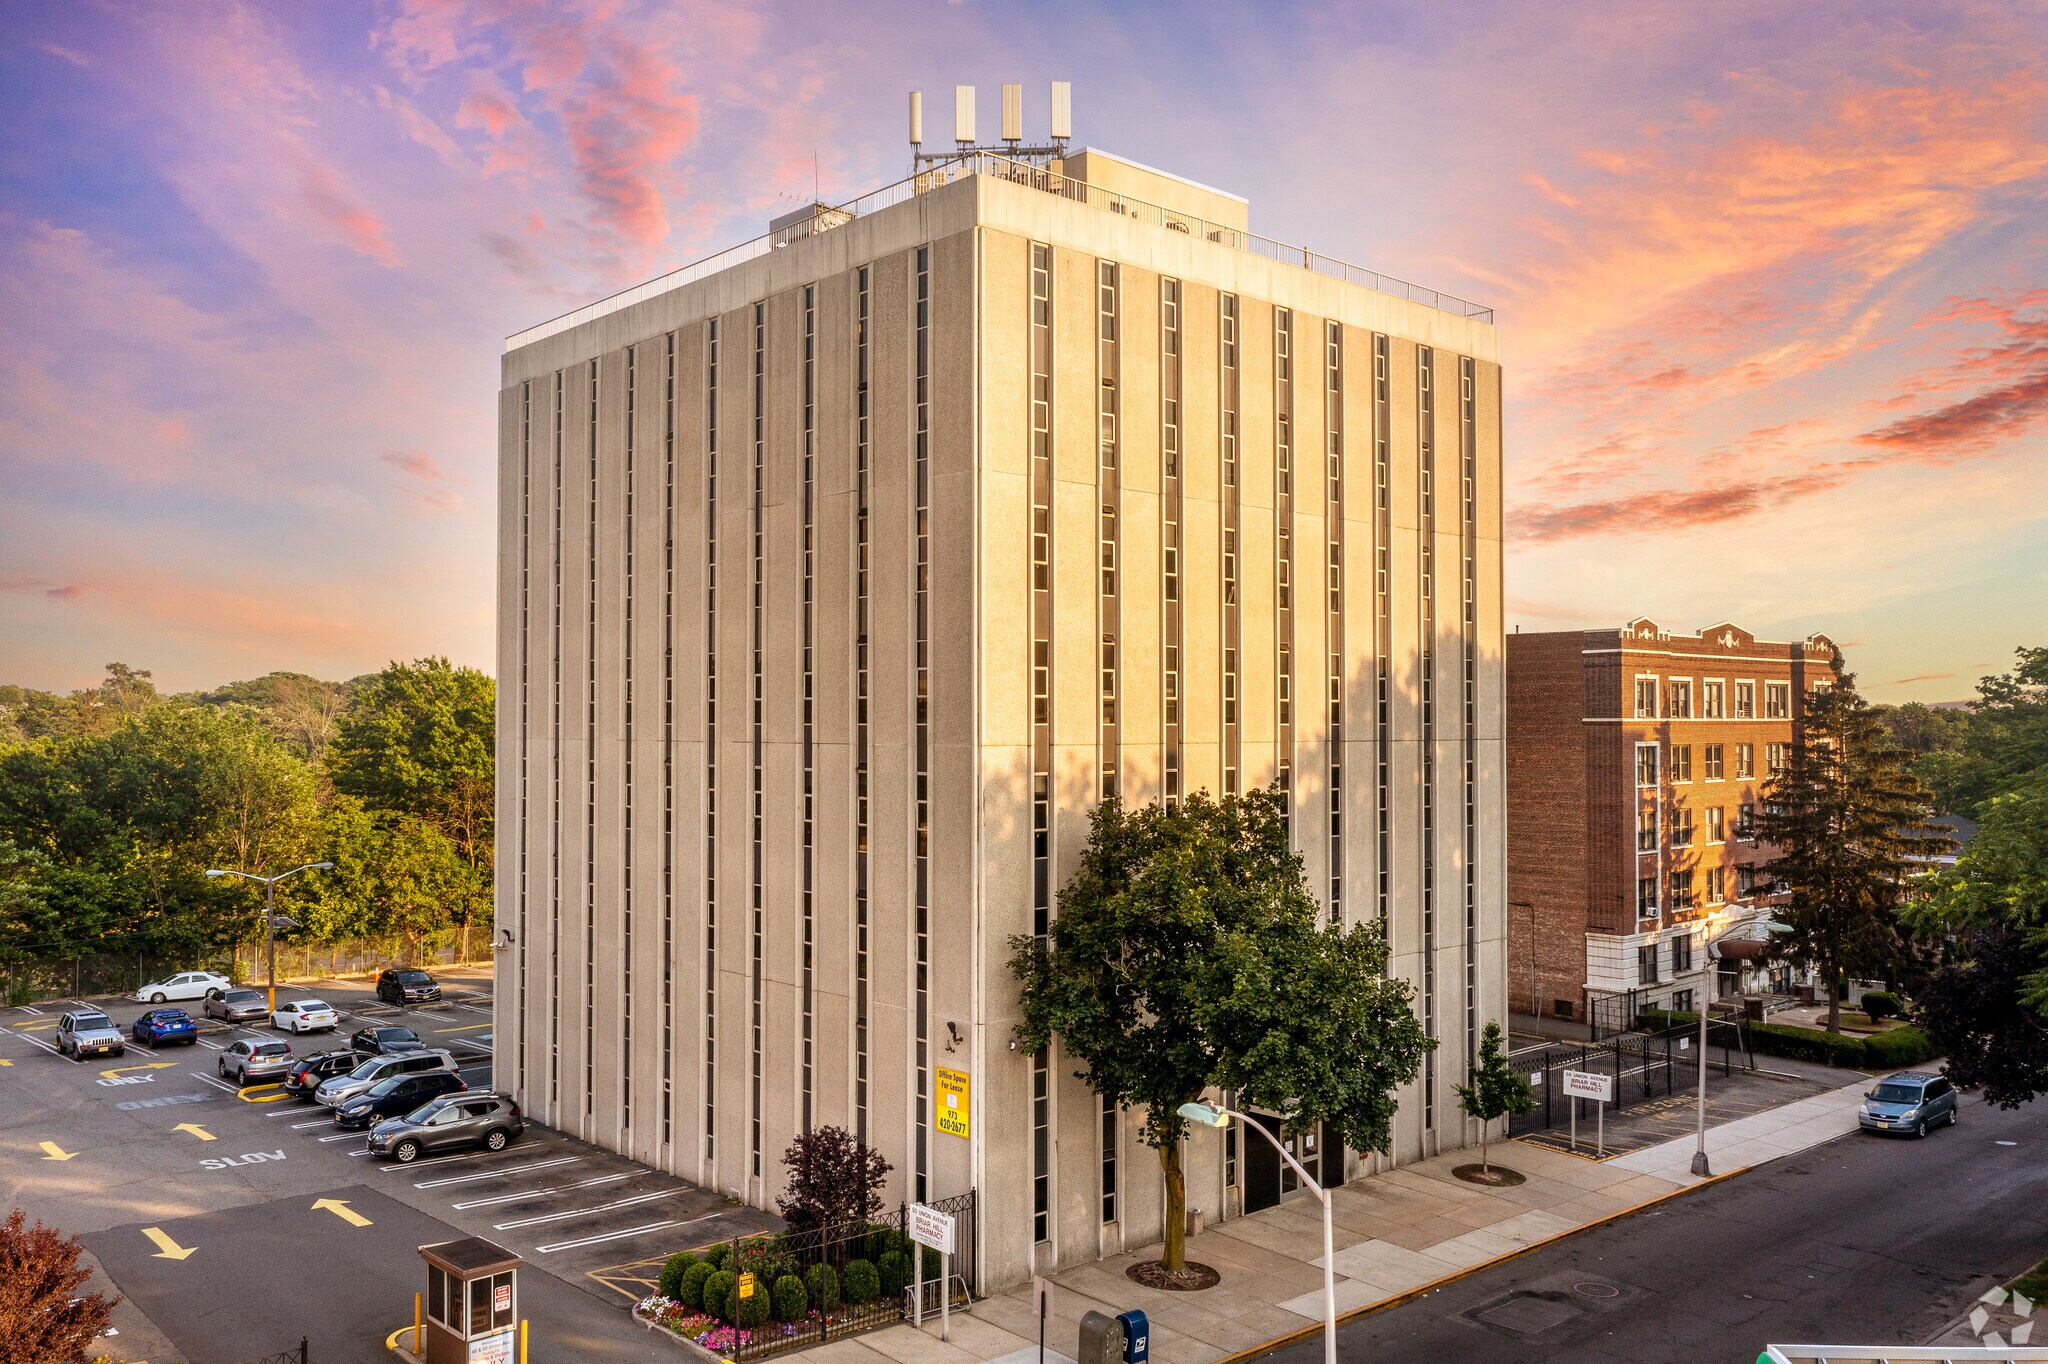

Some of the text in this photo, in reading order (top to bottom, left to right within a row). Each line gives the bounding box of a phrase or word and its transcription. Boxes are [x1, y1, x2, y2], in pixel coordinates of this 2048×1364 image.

[96, 1074, 155, 1087] ONLY
[938, 1069, 967, 1084] Office Space
[1570, 1078, 1589, 1086] BRIAR
[941, 1080, 963, 1093] For Lease
[1570, 1083, 1603, 1093] PHARMACY
[114, 1093, 210, 1111] ONLY
[947, 1109, 958, 1121] 973
[939, 1117, 966, 1134] 420-2677
[199, 1149, 287, 1170] SLOW
[916, 1216, 944, 1234] BRIAR HILL
[919, 1210, 932, 1220] UNION
[932, 1215, 949, 1227] AVENUE
[915, 1224, 944, 1241] PHARMACY
